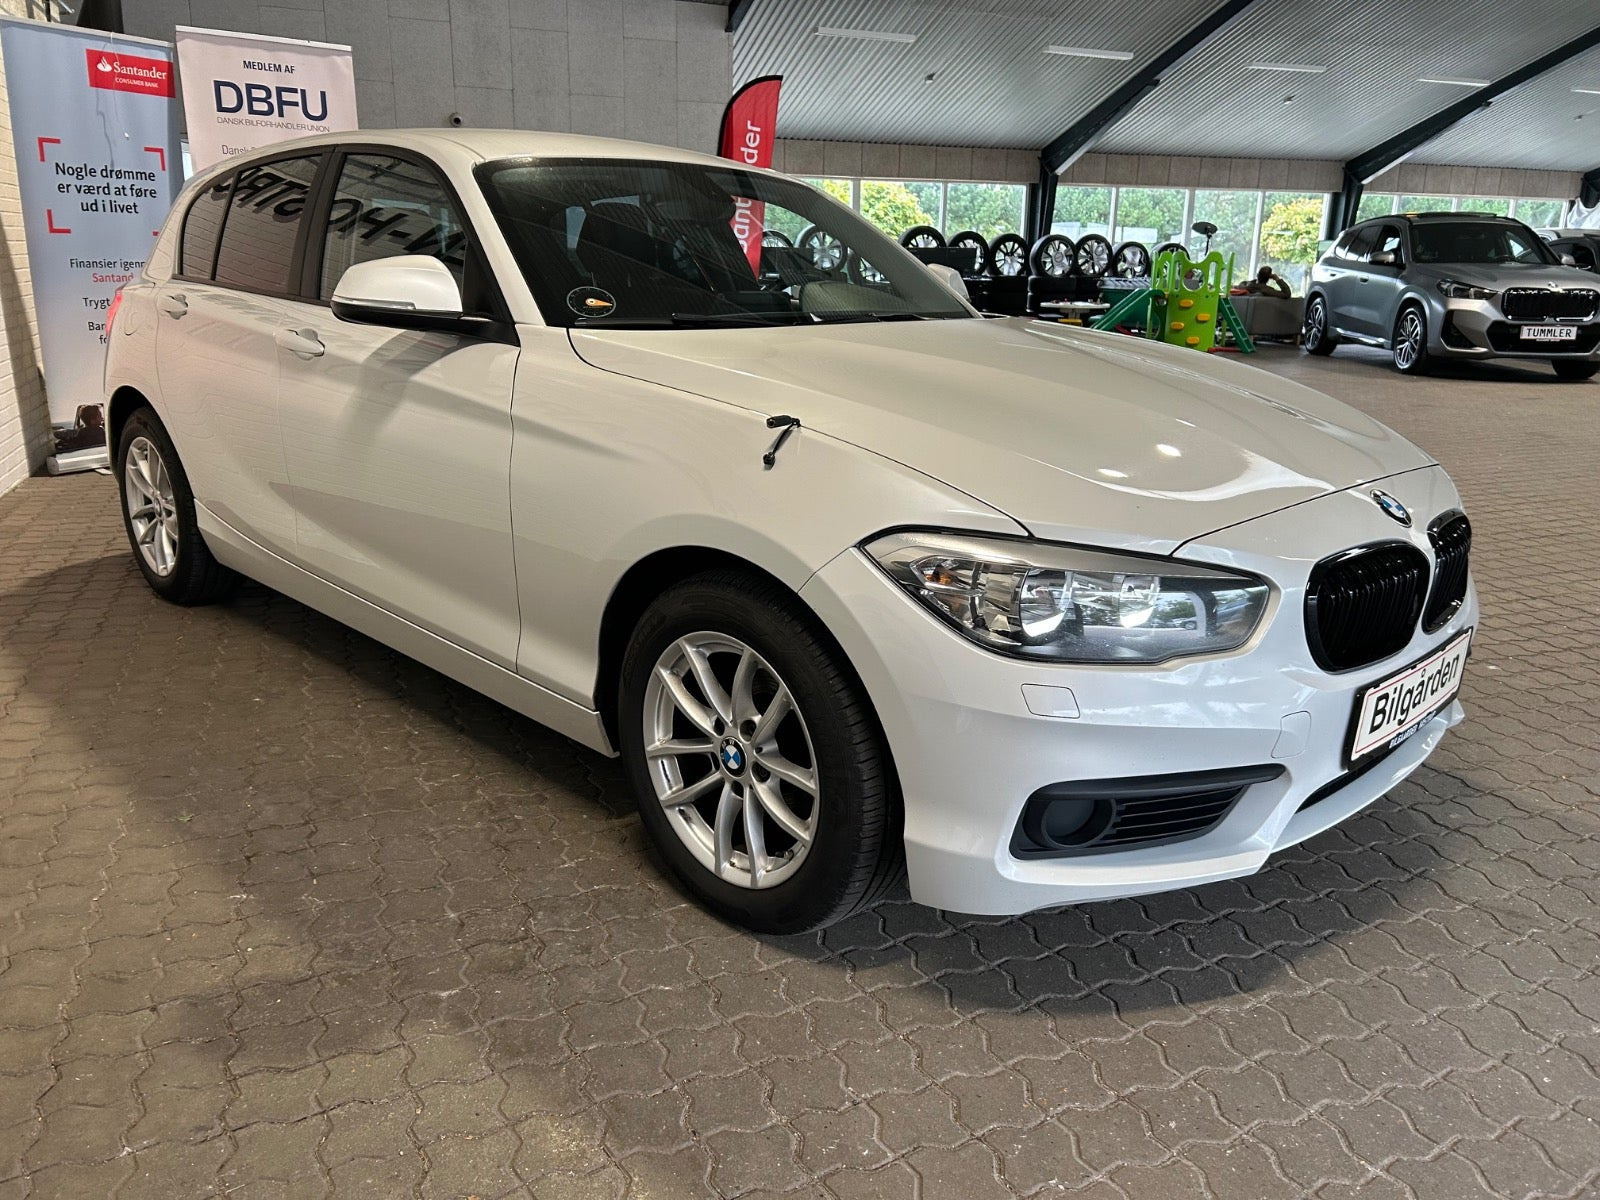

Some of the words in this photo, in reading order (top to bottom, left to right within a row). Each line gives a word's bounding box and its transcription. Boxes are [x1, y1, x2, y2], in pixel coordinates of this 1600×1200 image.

[113, 61, 167, 80] Santander
[243, 60, 282, 73] MEDLEM
[284, 64, 296, 74] AF
[115, 77, 144, 87] CONSUMER
[213, 80, 328, 122] DBFU
[216, 116, 245, 126] DANSK
[55, 162, 97, 181] Nogle
[100, 164, 156, 181] drømme
[57, 182, 71, 194] er
[74, 182, 111, 197] værd
[113, 184, 127, 197] at
[130, 183, 157, 198] føre
[80, 198, 98, 212] ud
[101, 199, 106, 213] i
[109, 199, 139, 214] livet
[69, 258, 117, 269] Finansier
[82, 297, 111, 310] Trygt
[1526, 328, 1572, 338] TUMMLER
[1368, 652, 1460, 736] Bilgården
